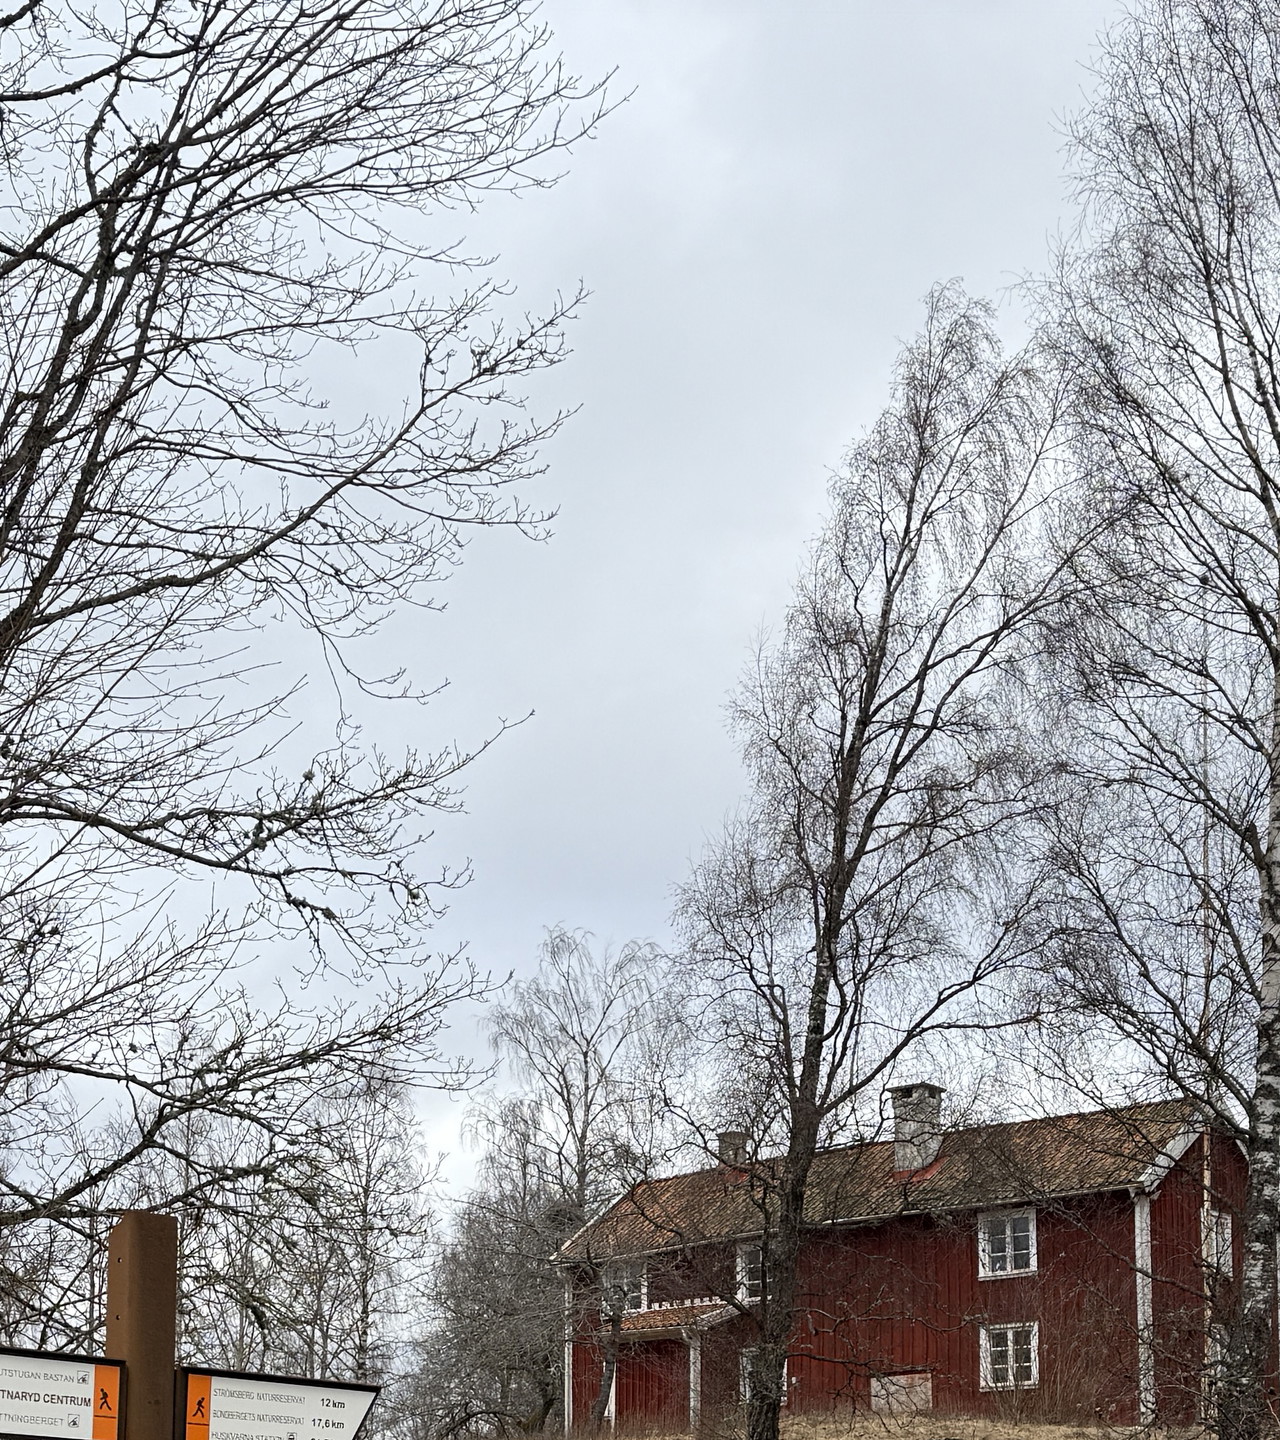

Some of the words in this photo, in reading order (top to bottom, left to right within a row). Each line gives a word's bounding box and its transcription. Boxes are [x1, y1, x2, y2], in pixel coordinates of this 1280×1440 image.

[43, 1393, 91, 1407] CENTRUM
[321, 1398, 331, 1408] 12
[332, 1399, 346, 1409] km
[311, 1418, 331, 1429] 17,6
[331, 1420, 345, 1429] km
